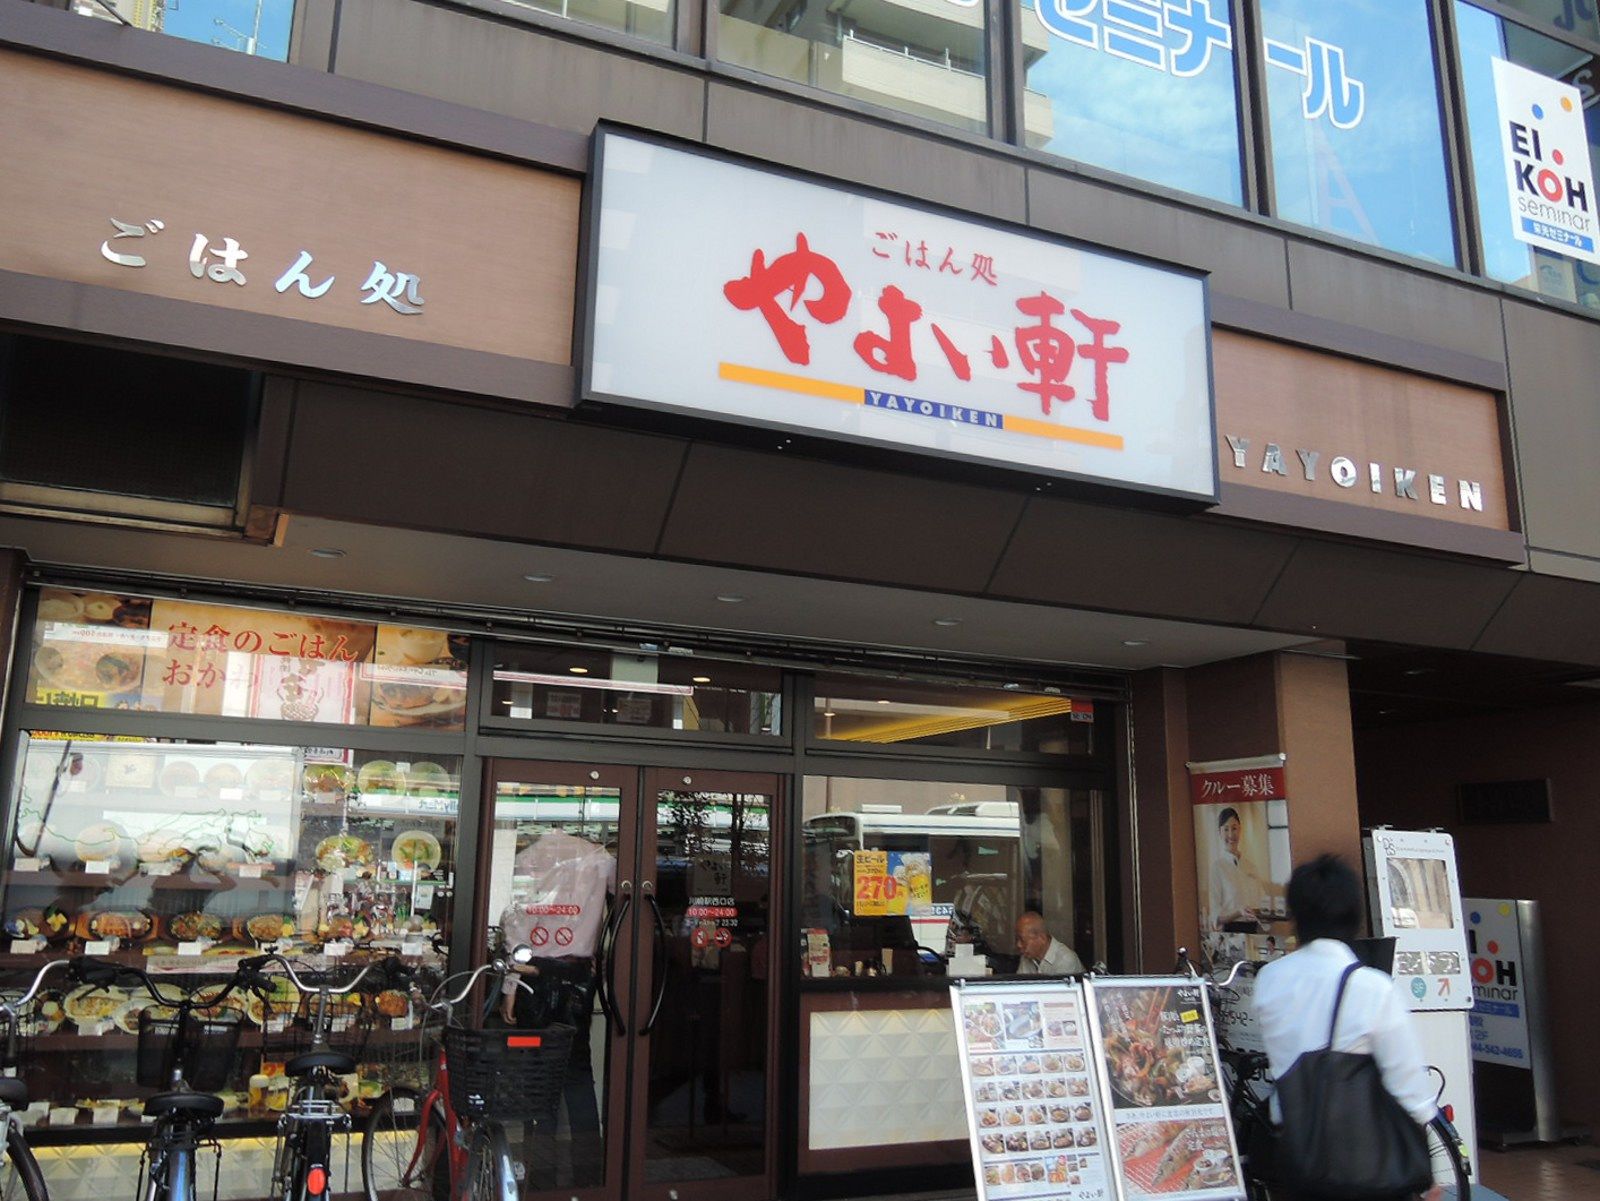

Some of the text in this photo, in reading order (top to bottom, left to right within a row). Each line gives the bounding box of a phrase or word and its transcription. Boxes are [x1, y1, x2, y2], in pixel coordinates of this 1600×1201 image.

[1509, 121, 1542, 161] EI
[1514, 160, 1588, 212] KOH
[1518, 197, 1591, 232] seminar
[101, 217, 424, 315] ごはん処
[872, 232, 998, 286] ごはん処
[723, 231, 1129, 421] やよい軒
[868, 393, 1001, 428] YAYOIKEN
[1225, 434, 1483, 512] YAYOIKEN
[168, 621, 358, 663] 定食のごはん
[1202, 774, 1274, 798] クルー募集
[1472, 958, 1517, 987] OH
[1472, 984, 1518, 1001] minar
